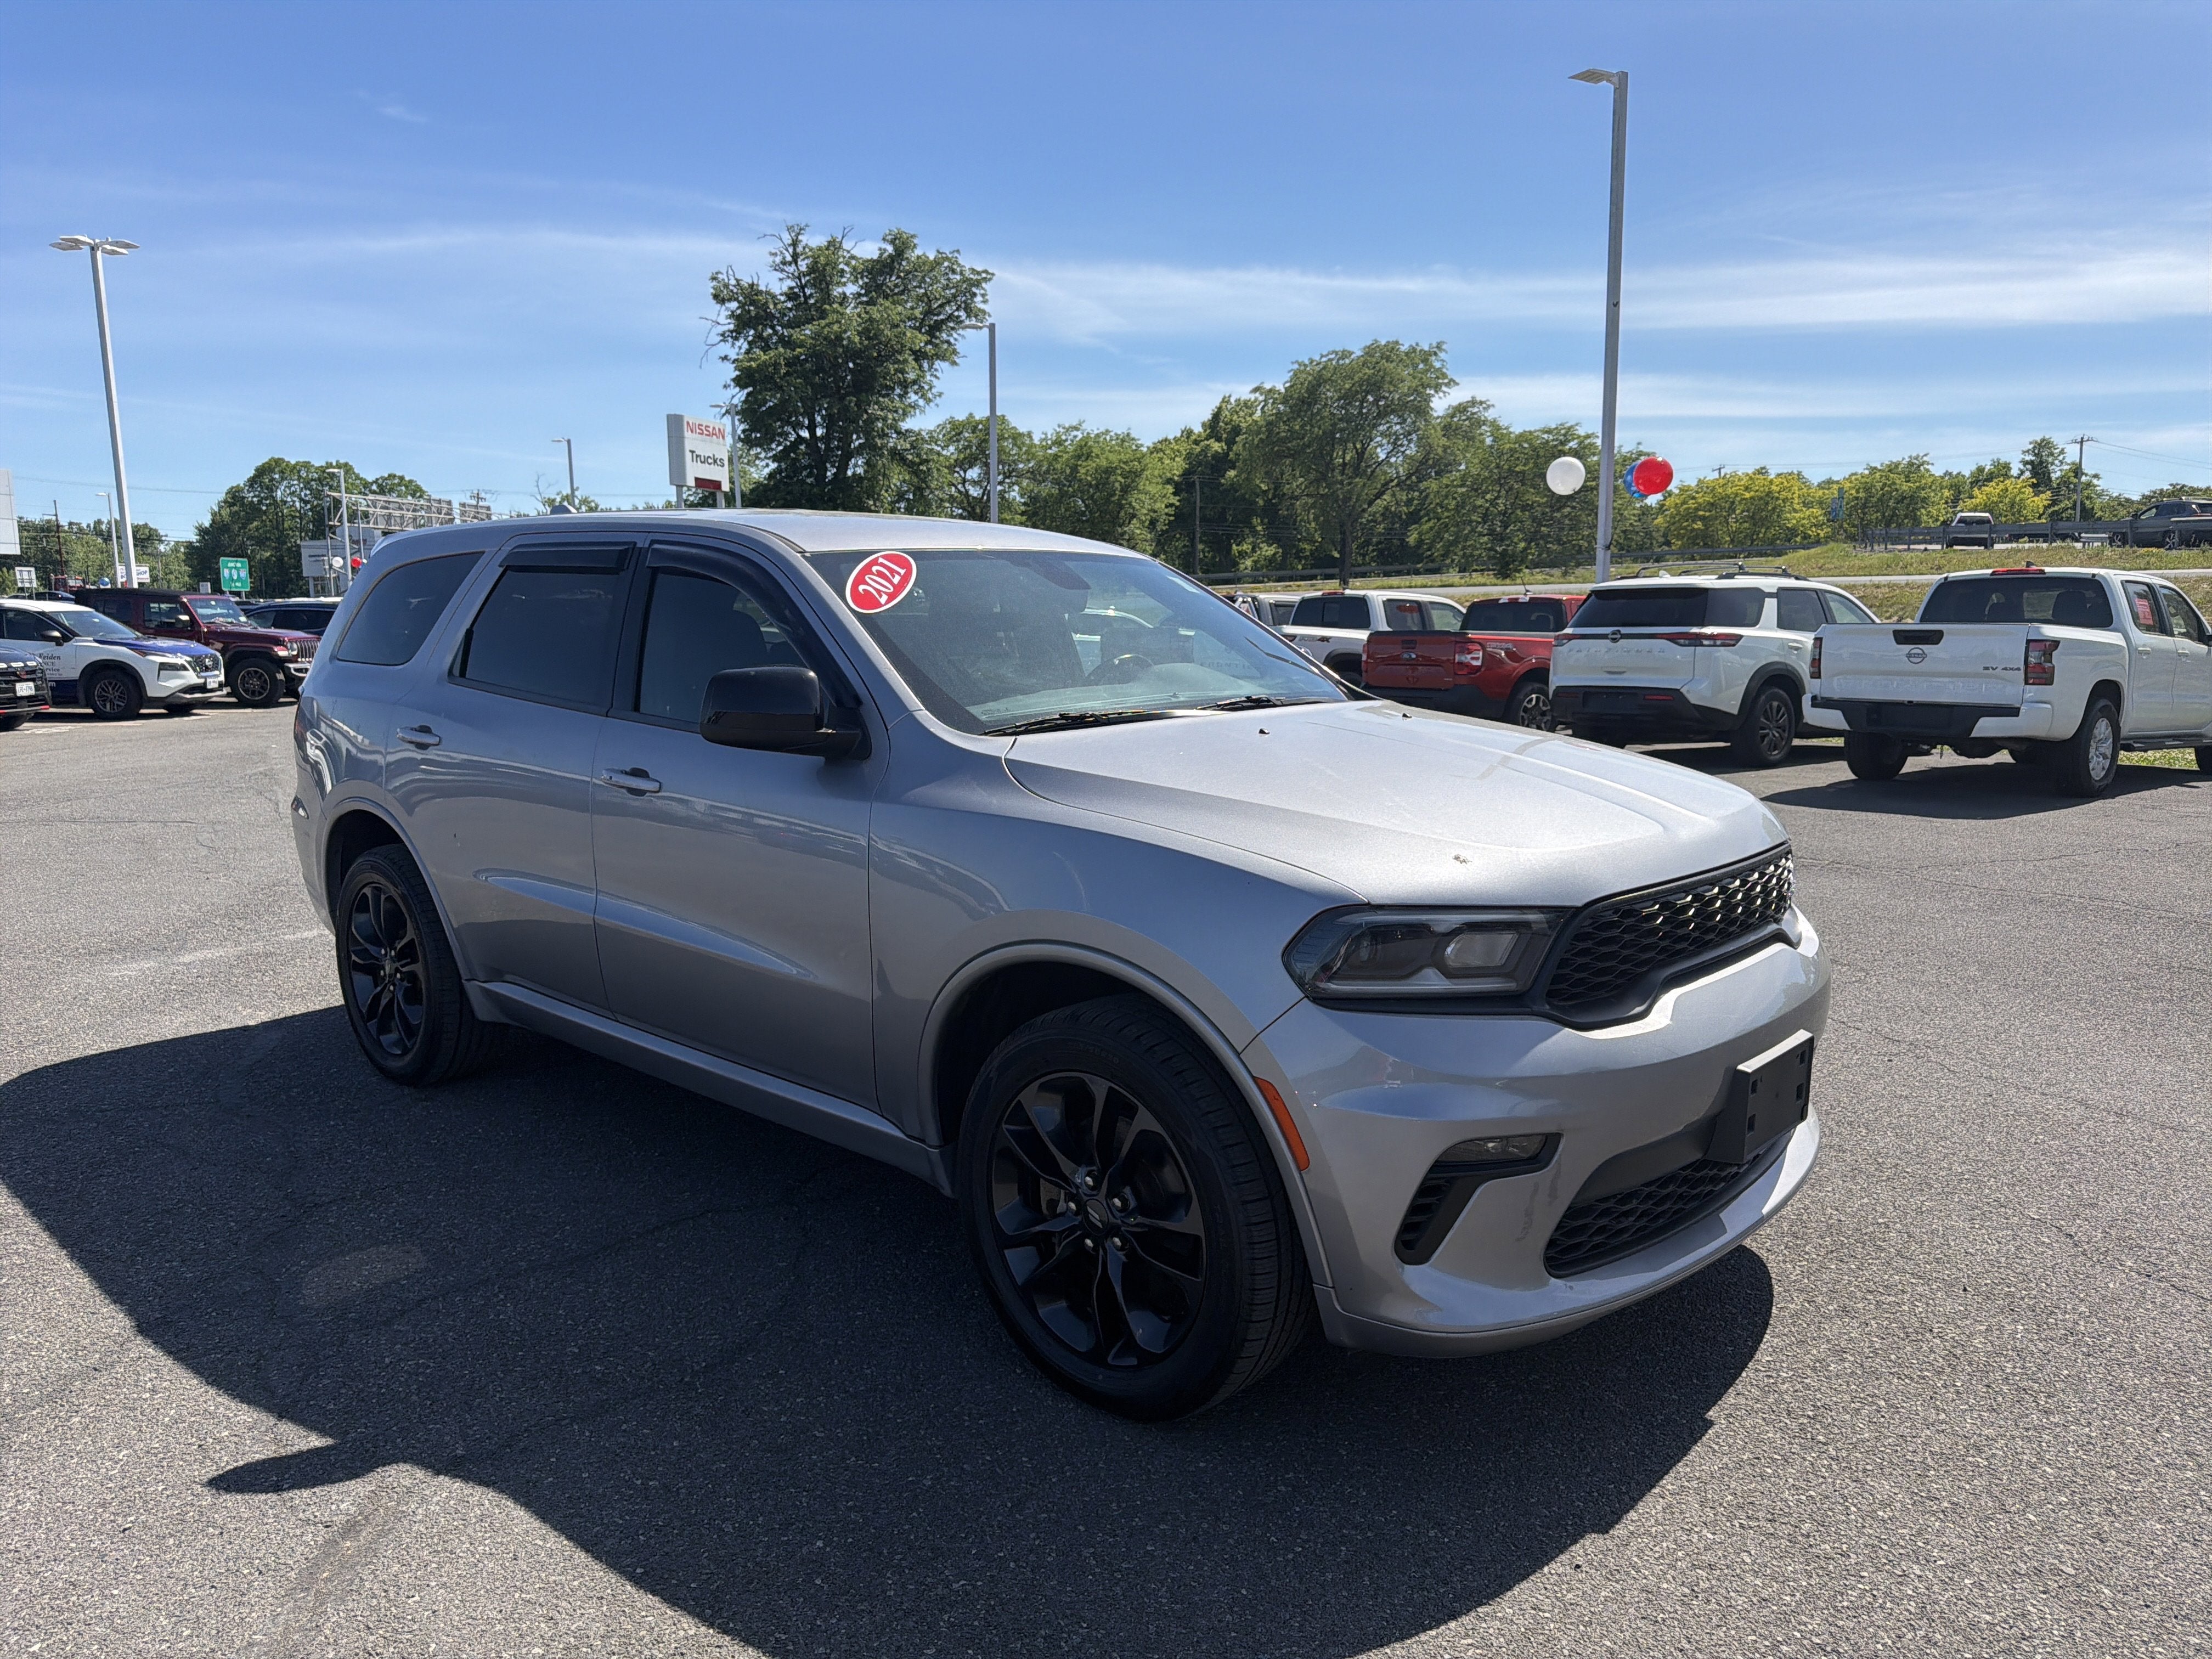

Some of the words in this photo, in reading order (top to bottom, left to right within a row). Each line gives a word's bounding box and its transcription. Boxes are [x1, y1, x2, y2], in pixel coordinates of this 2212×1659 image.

[686, 420, 725, 440] NISSAN
[689, 449, 725, 468] Trucks
[858, 557, 907, 605] 2021
